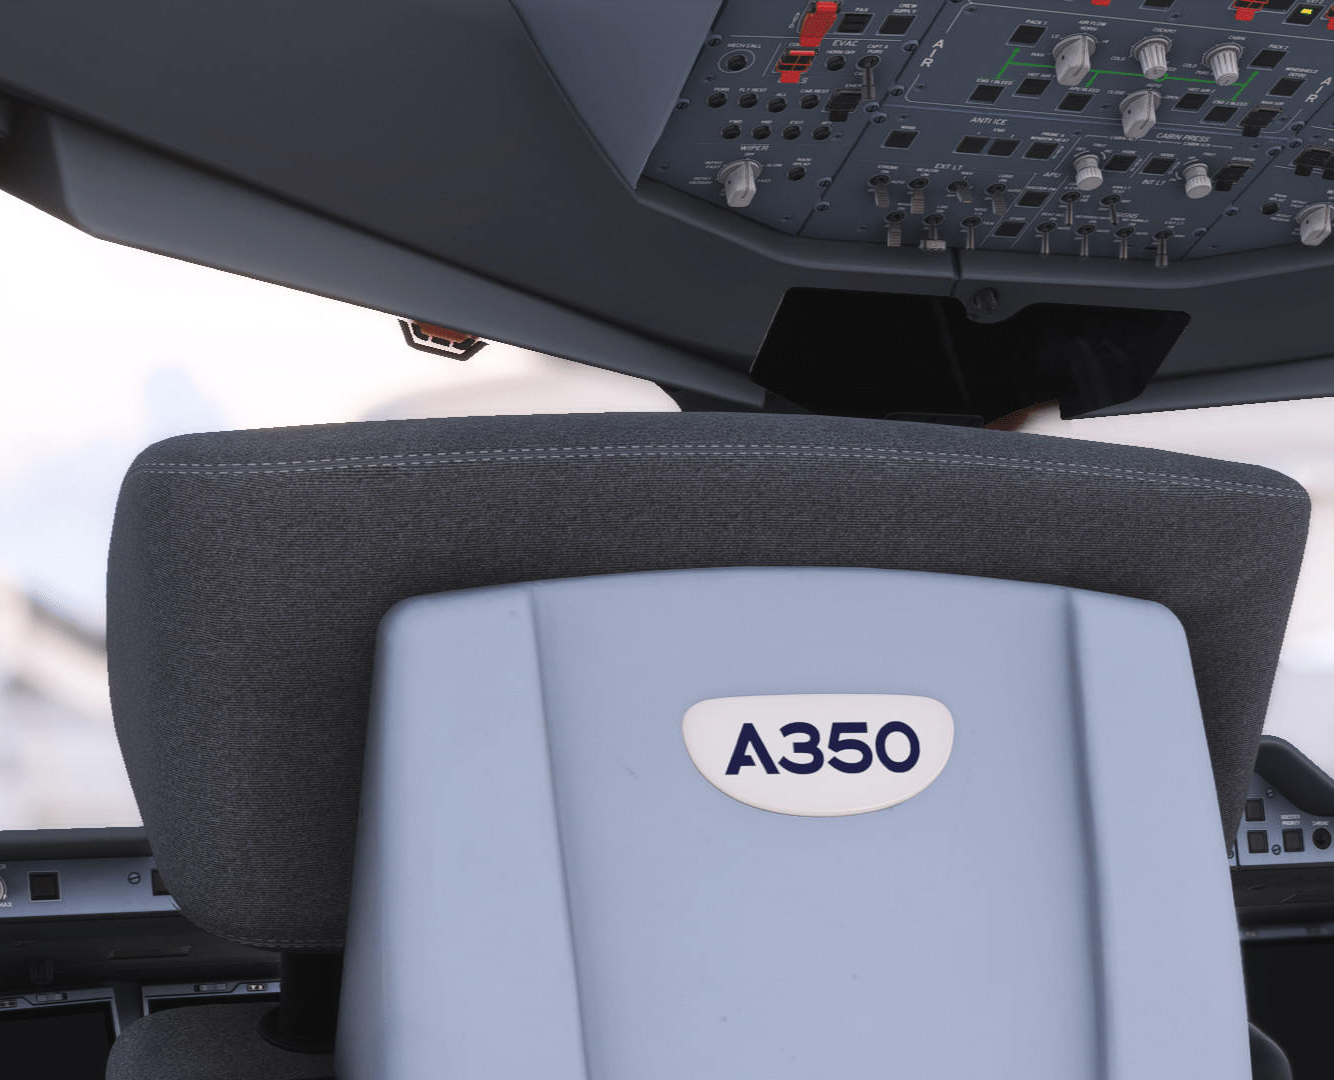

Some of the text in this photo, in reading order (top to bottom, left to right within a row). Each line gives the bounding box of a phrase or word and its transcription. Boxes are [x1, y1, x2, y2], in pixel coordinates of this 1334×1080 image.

[920, 39, 945, 68] AIR
[1304, 76, 1333, 103] AIR
[969, 116, 1008, 126] ANTI ICE
[1156, 132, 1211, 143] CABIN PRESS
[725, 721, 920, 775] A350
